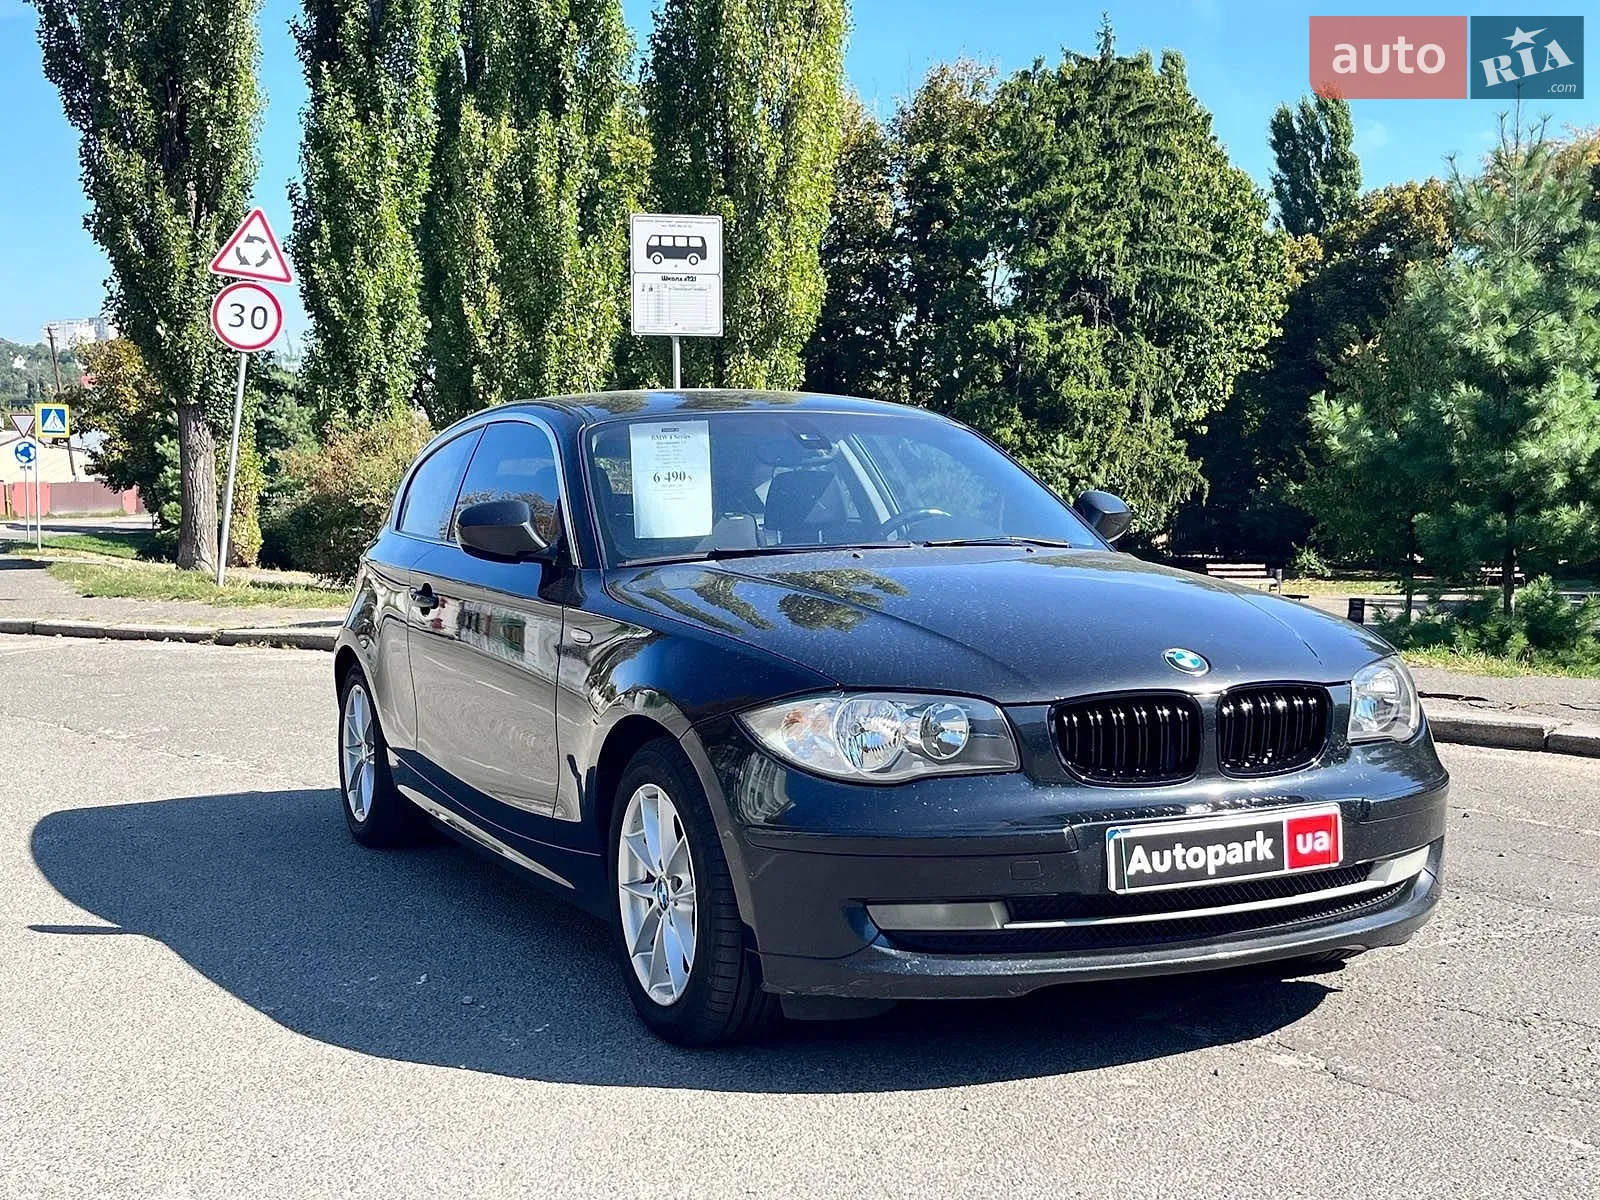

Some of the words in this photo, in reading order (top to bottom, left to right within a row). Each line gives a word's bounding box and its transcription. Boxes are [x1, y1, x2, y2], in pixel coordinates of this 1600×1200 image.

[228, 303, 268, 330] 30
[653, 471, 661, 484] 6
[664, 471, 686, 483] 490
[1127, 831, 1275, 876] Autopark
[1295, 830, 1331, 855] ua
